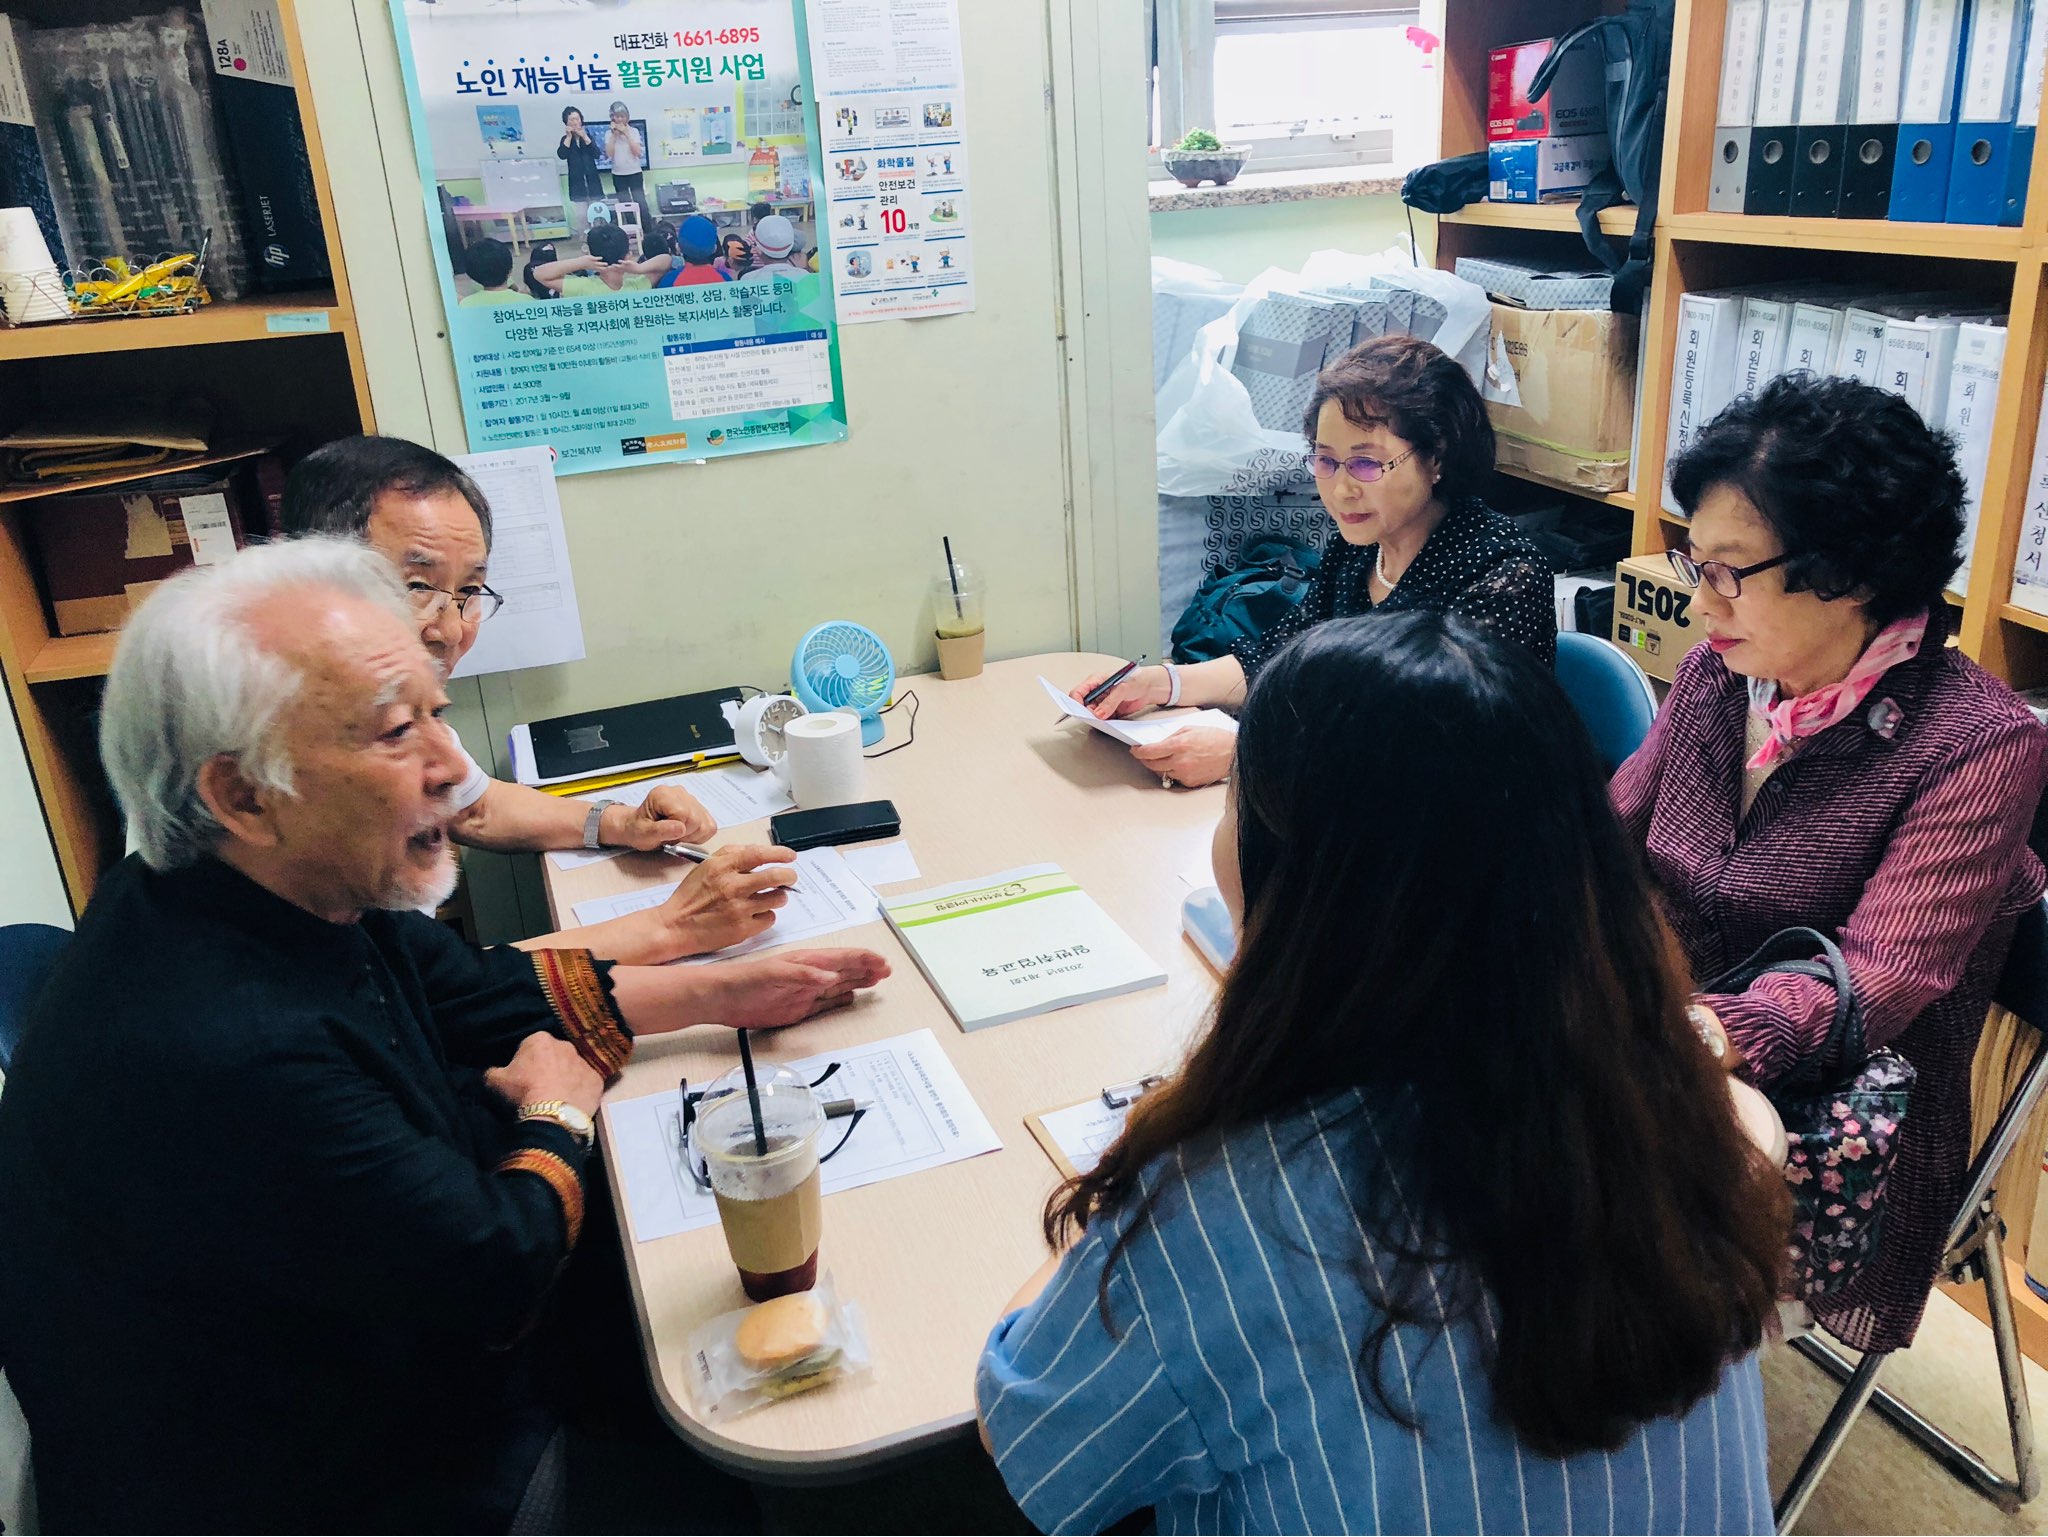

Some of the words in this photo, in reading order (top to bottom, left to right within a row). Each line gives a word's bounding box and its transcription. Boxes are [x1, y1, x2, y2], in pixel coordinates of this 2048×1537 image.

[614, 32, 668, 51] 대표전화
[673, 27, 760, 47] 1661-6895
[217, 39, 232, 69] 128A
[455, 68, 506, 95] 노인
[513, 61, 612, 95] 재능나눔
[617, 55, 713, 89] 활동지원
[720, 53, 766, 81] 사업
[1555, 108, 1577, 118] EOS
[877, 156, 915, 169] 화학물질
[878, 179, 916, 192] 안전보건
[879, 195, 898, 206] 관리
[260, 195, 277, 237] LASERJET
[880, 208, 907, 234] 10
[265, 246, 290, 266] hp
[493, 305, 549, 324] 참여노인의
[551, 303, 584, 318] 재능을
[587, 298, 630, 314] 활용하여
[632, 292, 699, 309] 노인안전예방,
[702, 288, 727, 303] 상담,
[729, 285, 771, 300] 학습지도
[773, 281, 793, 295] 동의
[506, 327, 539, 342] 다양한
[541, 323, 574, 338] 재능을
[577, 317, 631, 334] 지역사회에
[633, 311, 675, 328] 환원하는
[678, 307, 730, 324] 복지서비스
[732, 302, 787, 318] 활동입니다.
[561, 446, 602, 459] 보건복지부
[1621, 573, 1692, 628] 205L
[771, 702, 781, 713] 12
[791, 707, 798, 717] 2
[981, 944, 1091, 978] 일반취업교육
[1045, 962, 1085, 976] 2018년
[1009, 972, 1040, 986] 제1회
